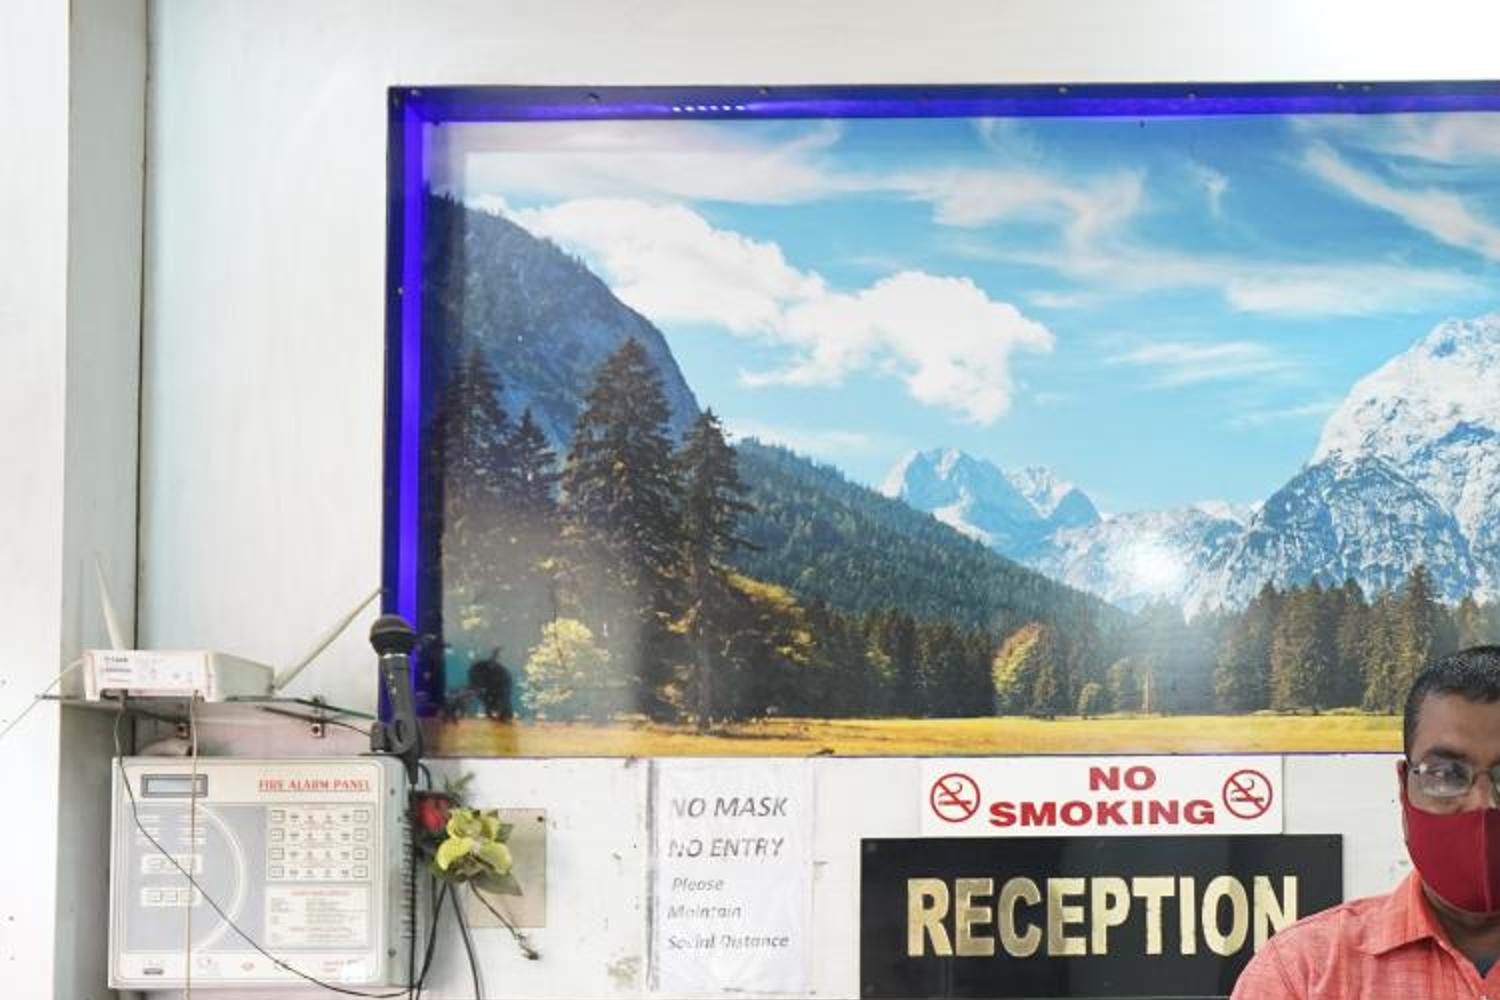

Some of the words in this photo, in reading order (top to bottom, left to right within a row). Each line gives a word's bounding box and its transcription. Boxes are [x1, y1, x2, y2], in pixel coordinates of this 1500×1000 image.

[259, 778, 285, 791] FIRE
[288, 778, 330, 791] ALARM
[333, 778, 371, 791] PANEL
[1088, 766, 1157, 791] NO
[670, 798, 706, 817] NO
[713, 796, 789, 817] MASK
[989, 799, 1216, 827] SMOKING
[668, 838, 703, 858] NO
[709, 837, 785, 858] ENTRY
[672, 877, 725, 892] Please
[906, 874, 1298, 958] RECEPTION
